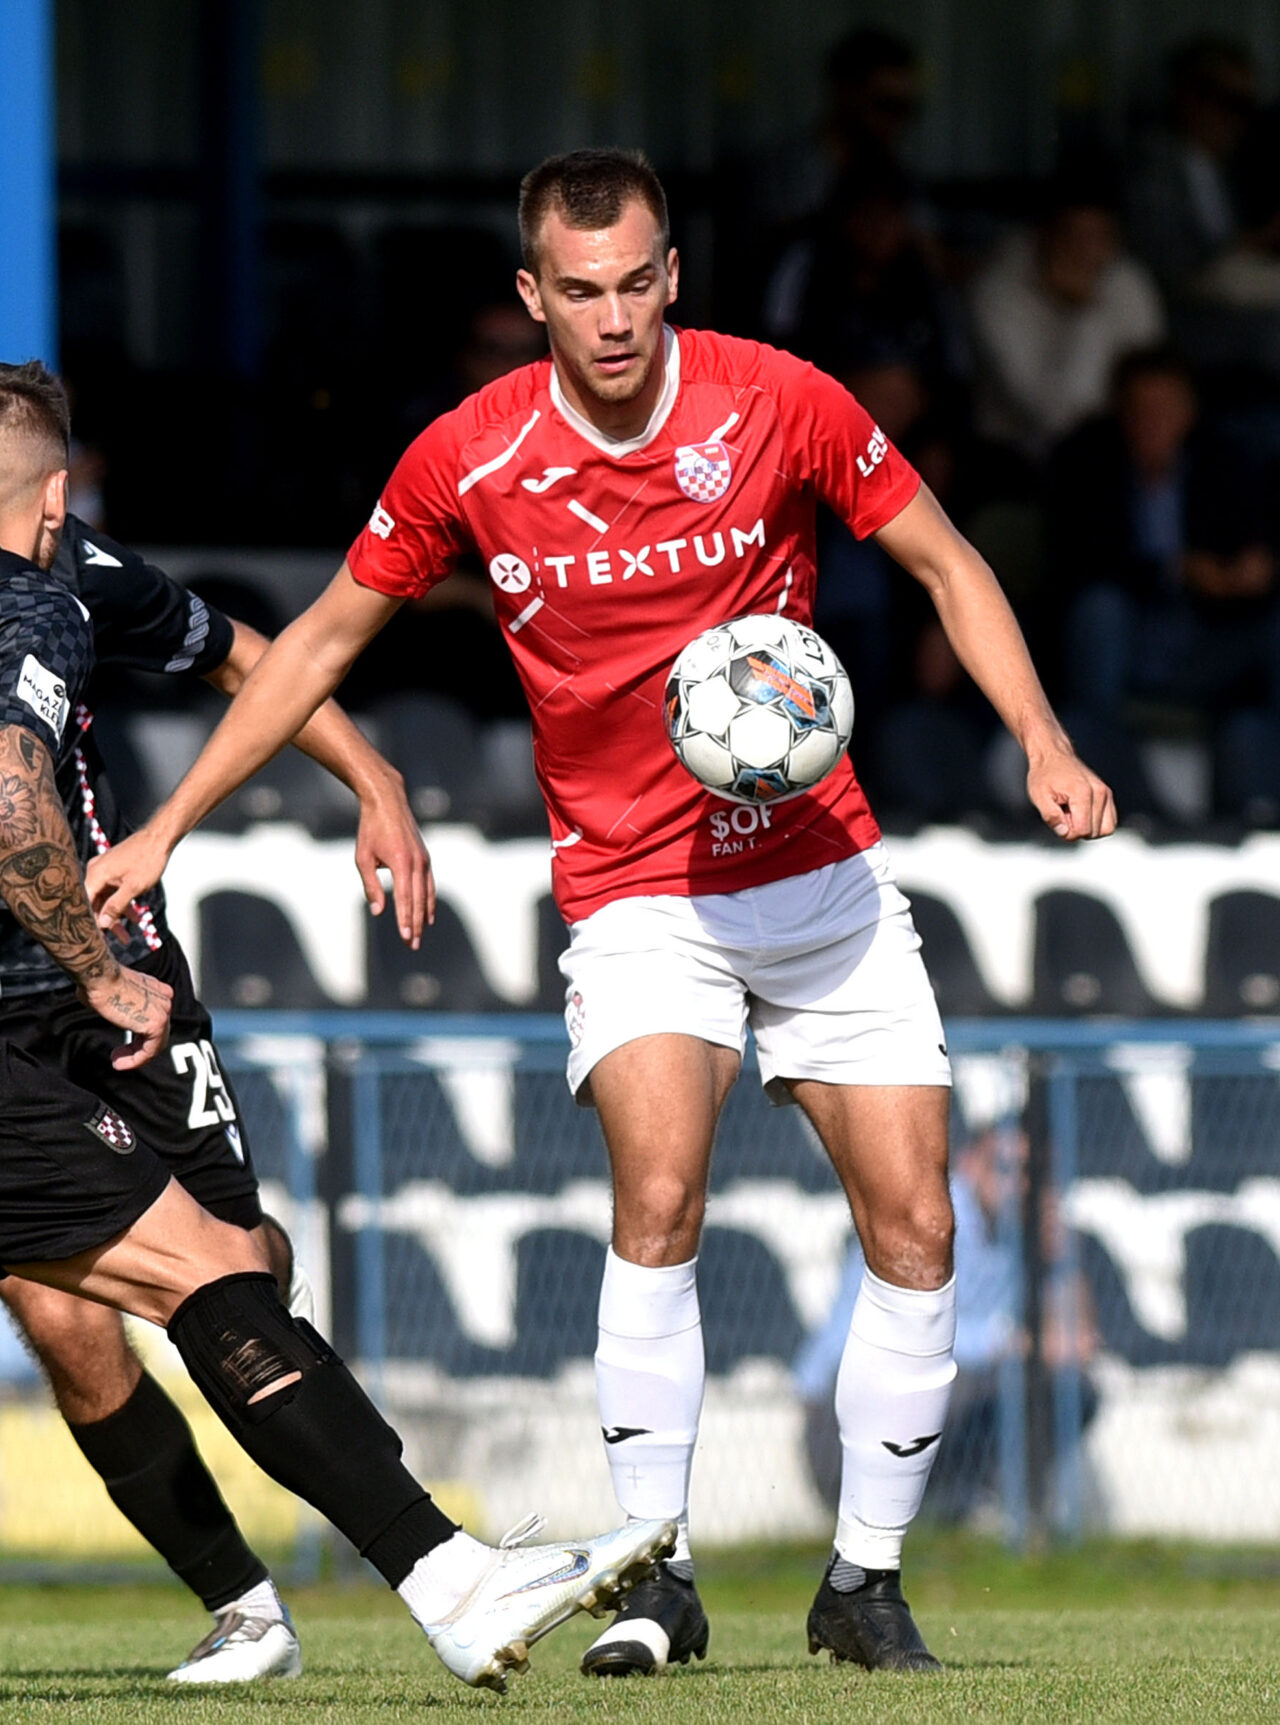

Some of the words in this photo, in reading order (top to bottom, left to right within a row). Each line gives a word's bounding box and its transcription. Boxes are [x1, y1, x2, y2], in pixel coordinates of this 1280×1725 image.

[543, 518, 766, 588] TEXTUM
[23, 674, 61, 712] MAGAZ
[711, 840, 744, 857] FAN
